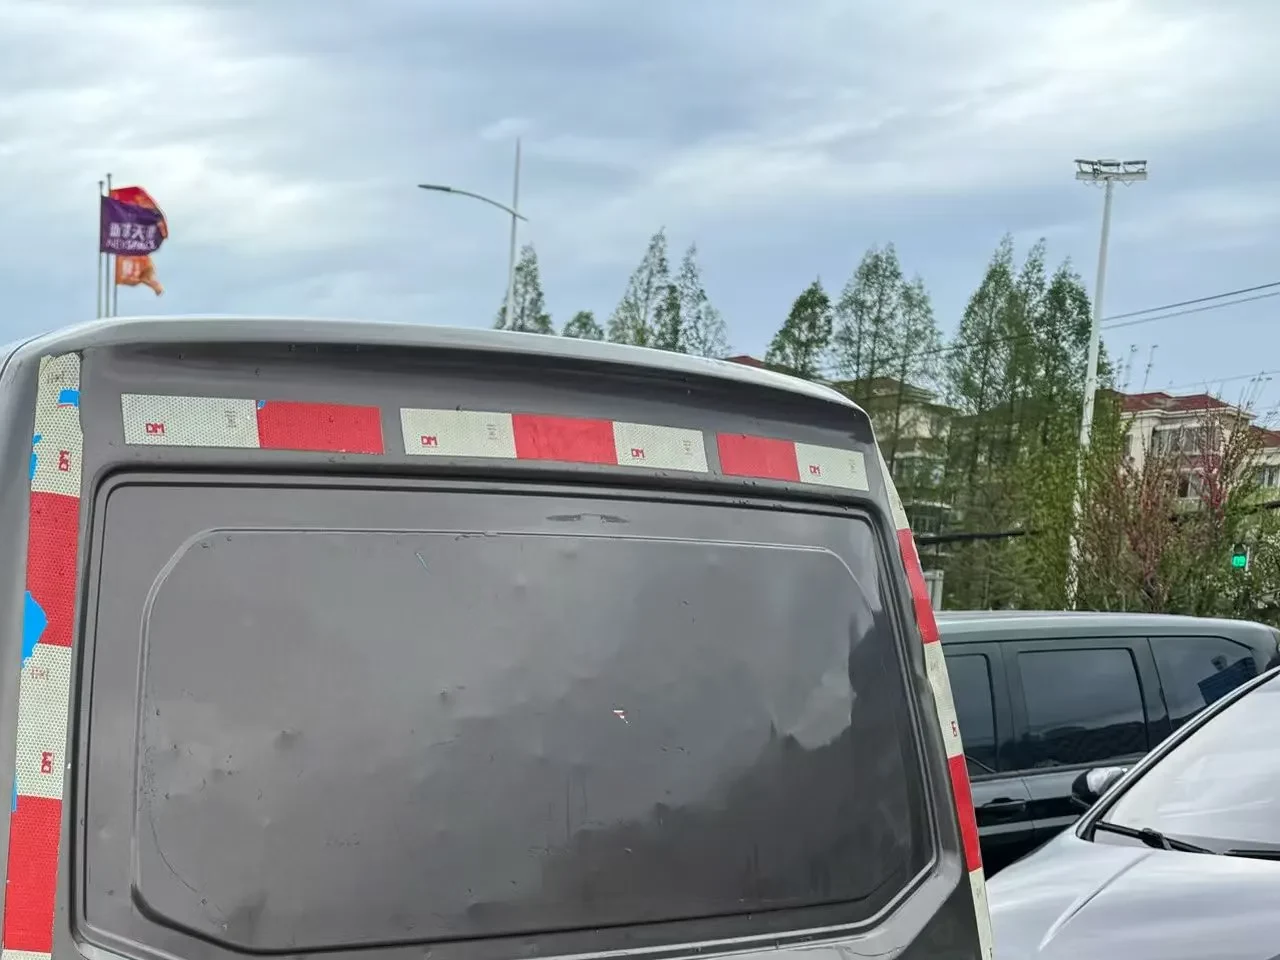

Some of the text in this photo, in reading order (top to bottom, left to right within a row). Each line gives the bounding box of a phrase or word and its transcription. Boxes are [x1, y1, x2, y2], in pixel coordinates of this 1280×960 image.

[145, 422, 165, 434] DM
[421, 435, 438, 446] DM
[631, 448, 645, 459] DM
[41, 751, 53, 774] DM
